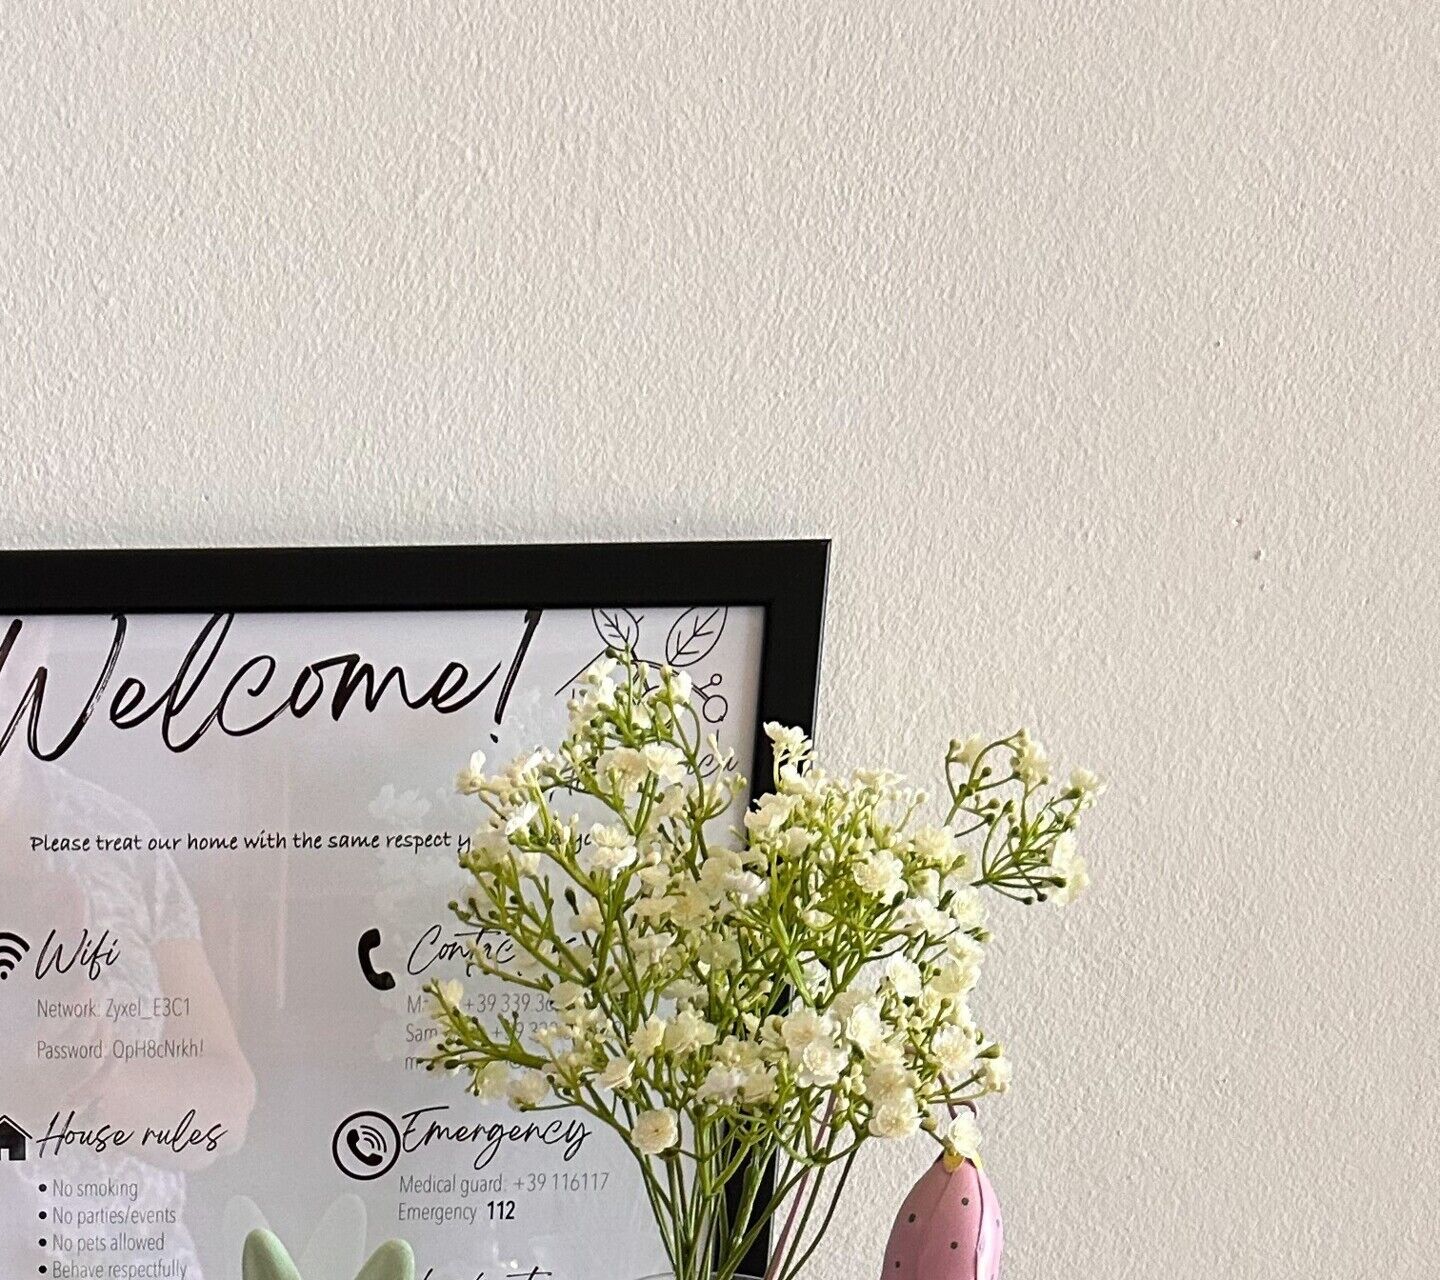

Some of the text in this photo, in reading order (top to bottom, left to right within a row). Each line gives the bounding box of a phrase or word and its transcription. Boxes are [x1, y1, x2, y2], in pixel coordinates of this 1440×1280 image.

[29, 829, 453, 855] Please treat our home with the same respect
[34, 928, 122, 982] Wifi
[105, 997, 192, 1021] Zyxel_E3C1
[111, 1039, 205, 1063] QpH8cNrkh!
[35, 1108, 229, 1159] House rules
[401, 1104, 594, 1171] Emergency
[51, 1178, 139, 1201] No smoking
[399, 1173, 457, 1194] Medical
[513, 1172, 547, 1193] +39
[552, 1172, 611, 1192] 116117
[51, 1205, 177, 1227] No parties/events
[486, 1201, 517, 1220] 112
[51, 1232, 166, 1254] No pets allowed
[51, 1259, 188, 1280] Behave respectfully
